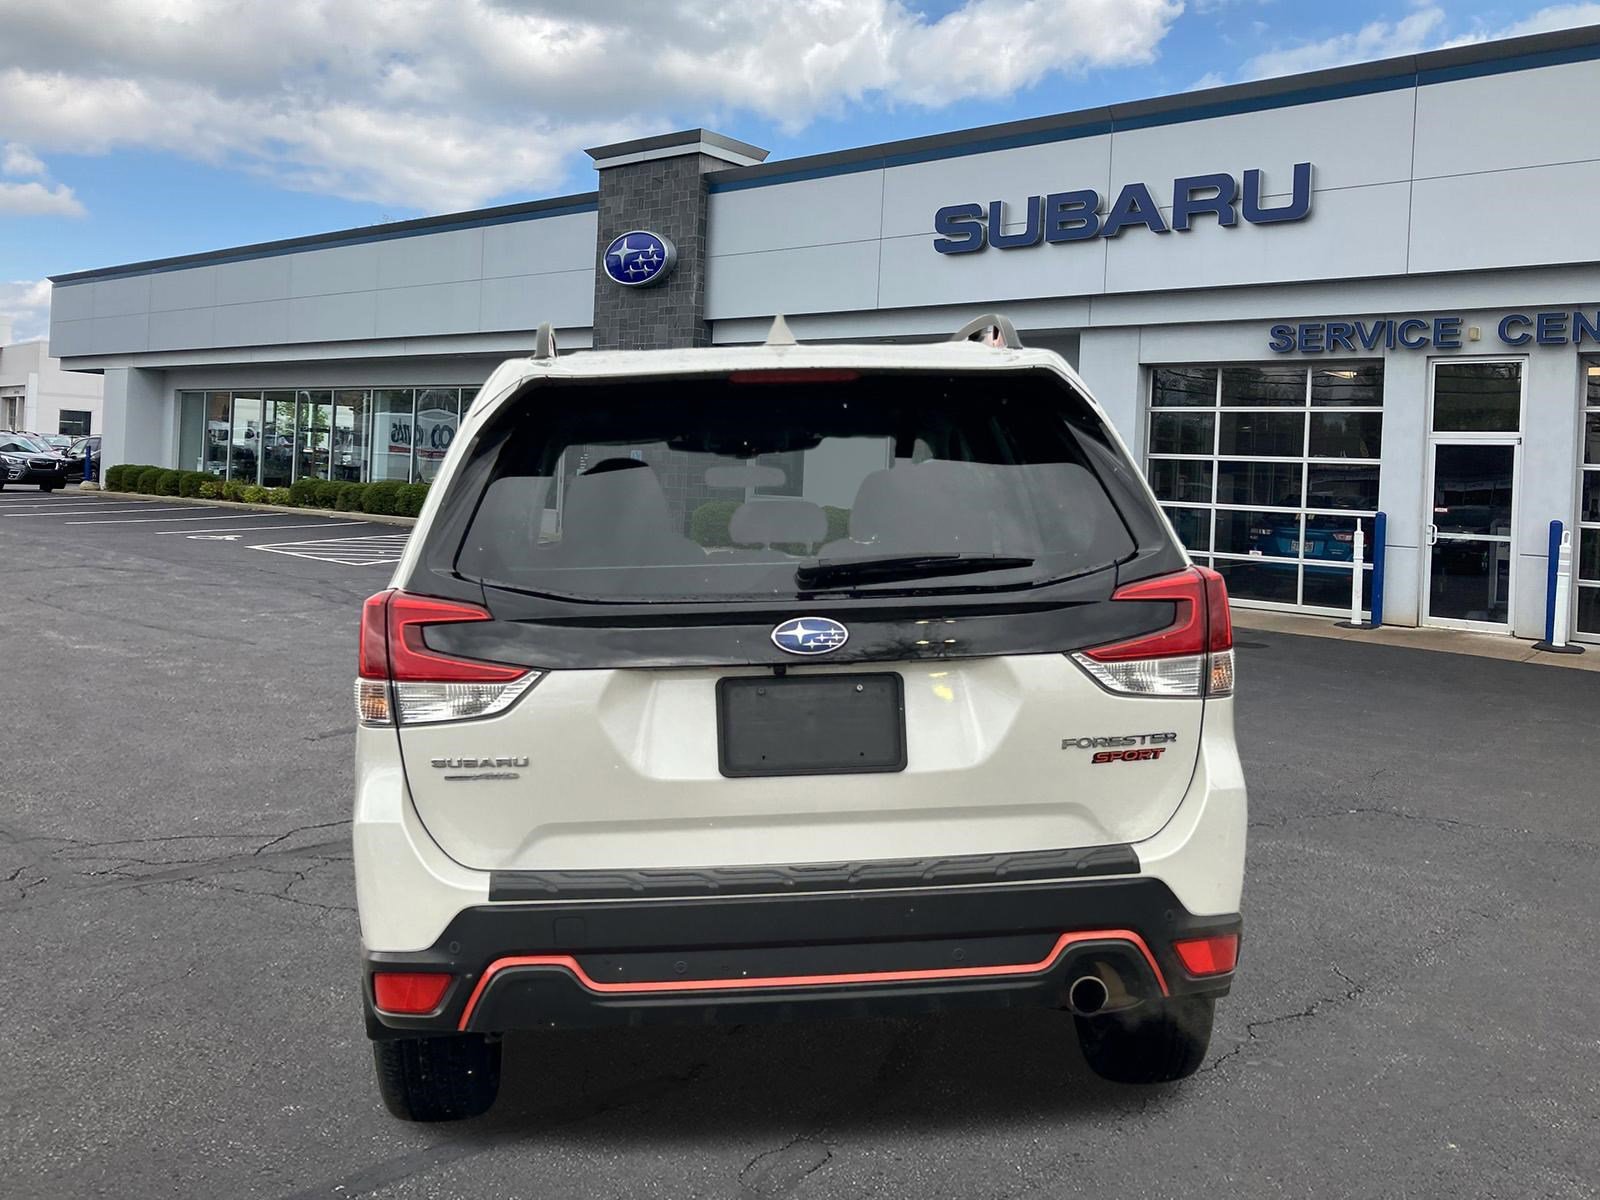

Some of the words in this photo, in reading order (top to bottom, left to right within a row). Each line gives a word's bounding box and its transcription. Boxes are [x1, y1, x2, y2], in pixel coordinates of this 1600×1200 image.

[933, 161, 1313, 255] SUBARU
[1269, 317, 1463, 353] SERVICE
[1497, 310, 1600, 346] CEN
[1061, 732, 1177, 750] FORESTER
[430, 756, 530, 769] SUBARU
[1091, 747, 1166, 764] SPORT
